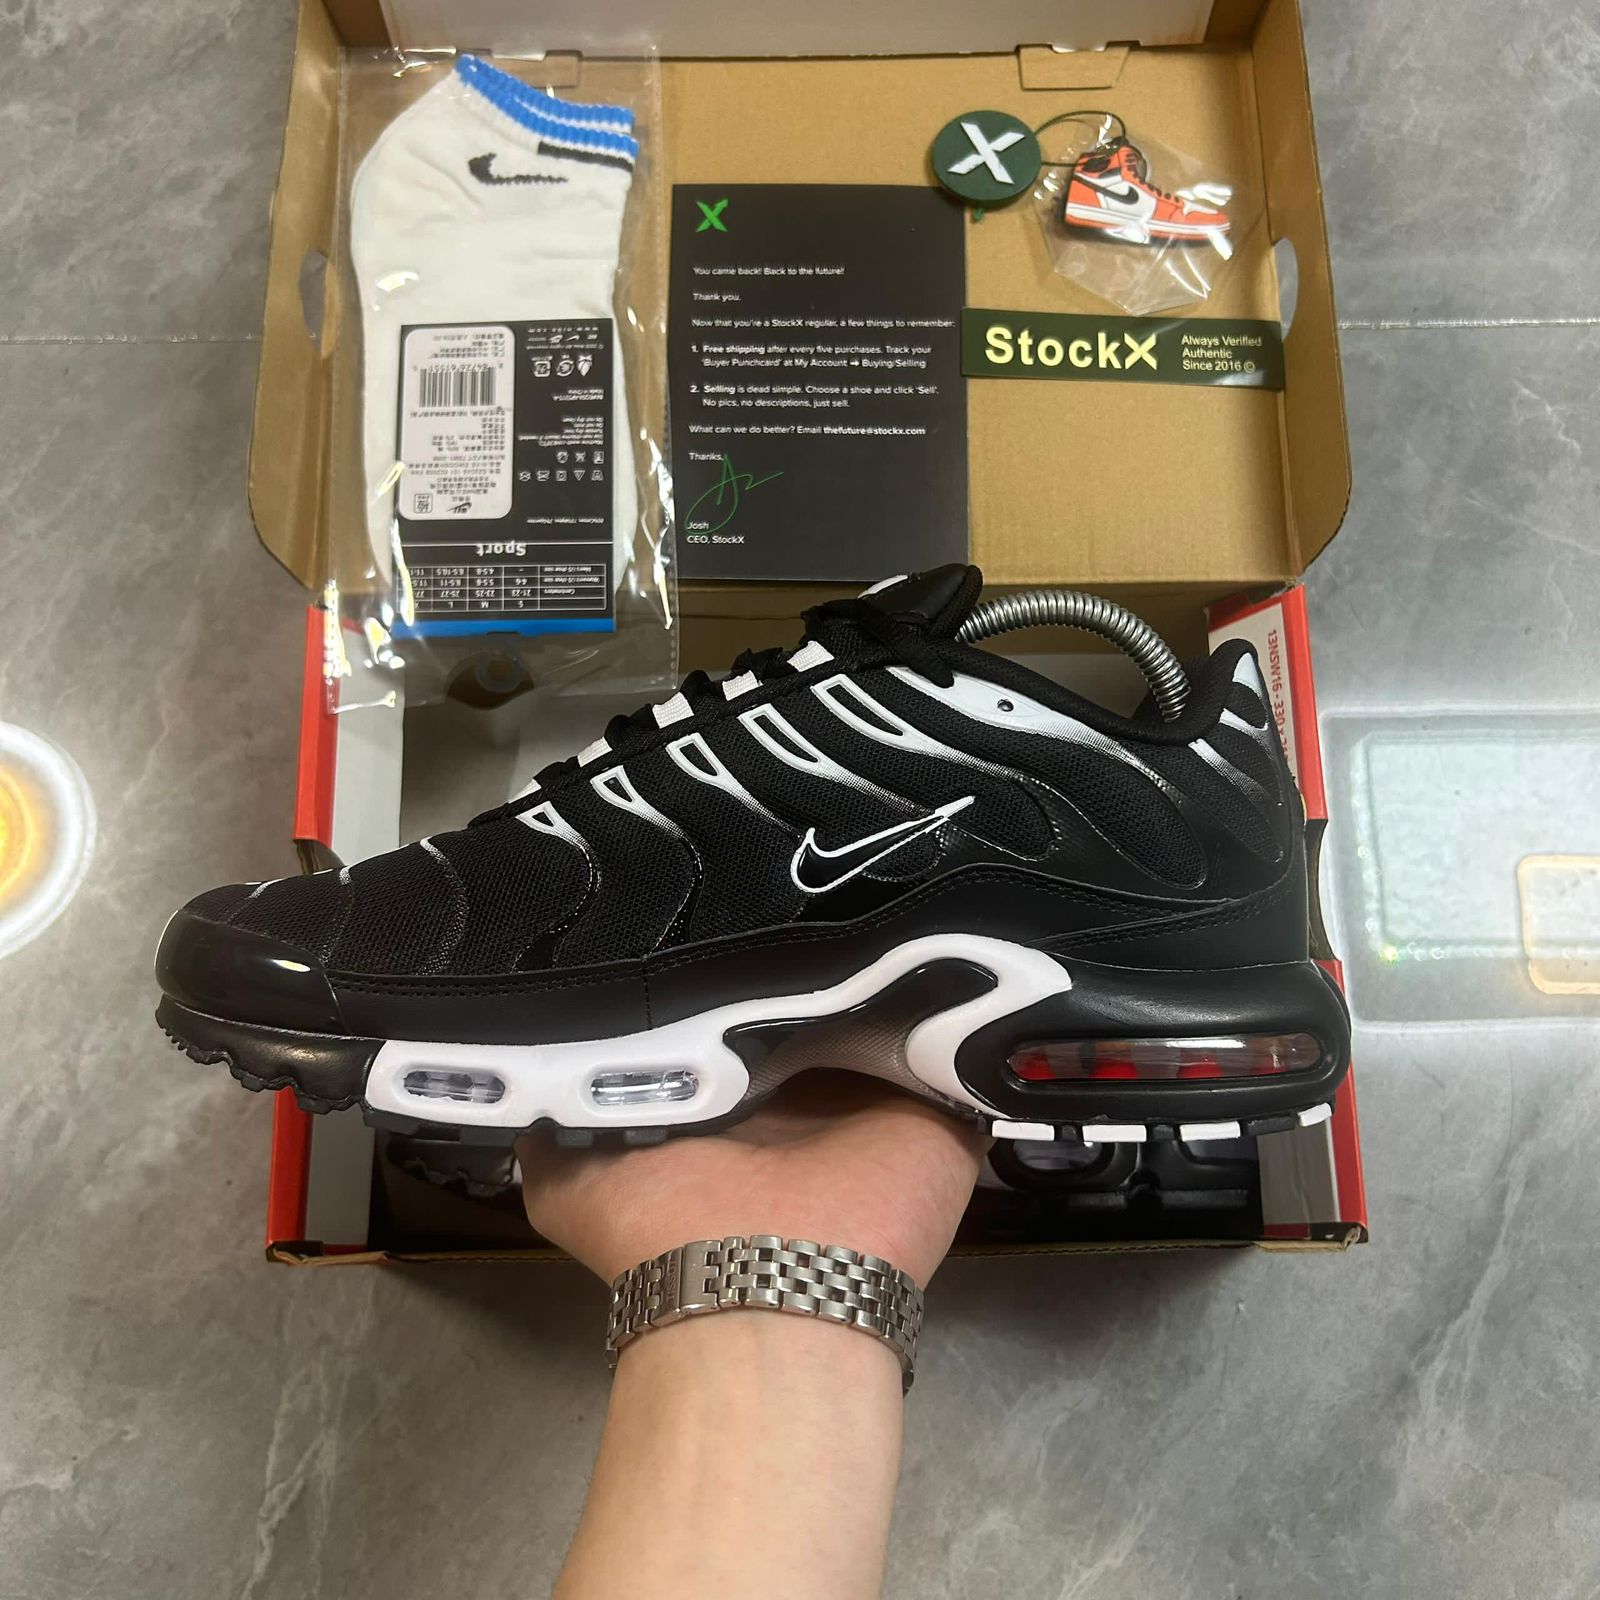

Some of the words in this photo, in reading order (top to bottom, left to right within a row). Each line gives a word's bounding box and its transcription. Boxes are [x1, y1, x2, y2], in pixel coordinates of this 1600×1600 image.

[692, 266, 711, 277] You
[711, 268, 737, 276] came
[737, 266, 763, 276] back!
[763, 266, 787, 276] Back
[787, 267, 798, 276] to
[798, 266, 814, 276] the
[814, 266, 845, 276] future!
[692, 292, 721, 301] Thank
[721, 294, 742, 303] you.
[691, 318, 714, 327] Now
[714, 318, 733, 327] that
[771, 318, 804, 328] StockX
[839, 319, 847, 327] a
[847, 318, 866, 328] few
[865, 319, 895, 329] things
[895, 319, 906, 328] to
[906, 318, 956, 328] remember:
[1182, 335, 1219, 347] Always
[1222, 337, 1262, 347] Verified
[691, 344, 699, 353] 1.
[702, 344, 725, 354] Free
[725, 344, 766, 355] shipping
[766, 344, 788, 354] after
[789, 346, 816, 355] every
[816, 344, 834, 354] five
[834, 345, 883, 355] purchases.
[885, 345, 910, 354] Track
[911, 346, 932, 356] your
[985, 326, 1157, 370] StockX
[1182, 348, 1232, 359] Authentic
[783, 359, 794, 367] at
[794, 358, 809, 369] My
[809, 358, 848, 367] Account
[1182, 360, 1212, 371] Since
[1215, 360, 1241, 371] 2016
[689, 384, 700, 393] 2.
[703, 384, 736, 395] Selling
[737, 385, 746, 394] is
[746, 385, 771, 394] dead
[771, 385, 803, 395] simple.
[804, 385, 841, 394] Choose
[849, 386, 873, 395] shoe
[873, 386, 892, 394] and
[892, 385, 915, 395] click
[702, 398, 717, 407] No
[740, 399, 754, 407] no
[754, 398, 813, 408] descriptions,
[813, 399, 831, 409] just
[831, 399, 850, 408] sell.
[688, 424, 714, 434] What
[714, 426, 732, 434] can
[732, 426, 748, 434] we
[748, 425, 762, 434] do
[762, 425, 796, 434] better?
[796, 425, 822, 434] Email
[686, 534, 711, 544] CEO,
[711, 535, 745, 544] StockX
[475, 541, 527, 557] Sport
[518, 600, 524, 608] S
[1267, 629, 1283, 692] 13NSW16
[1273, 700, 1286, 725] 330
